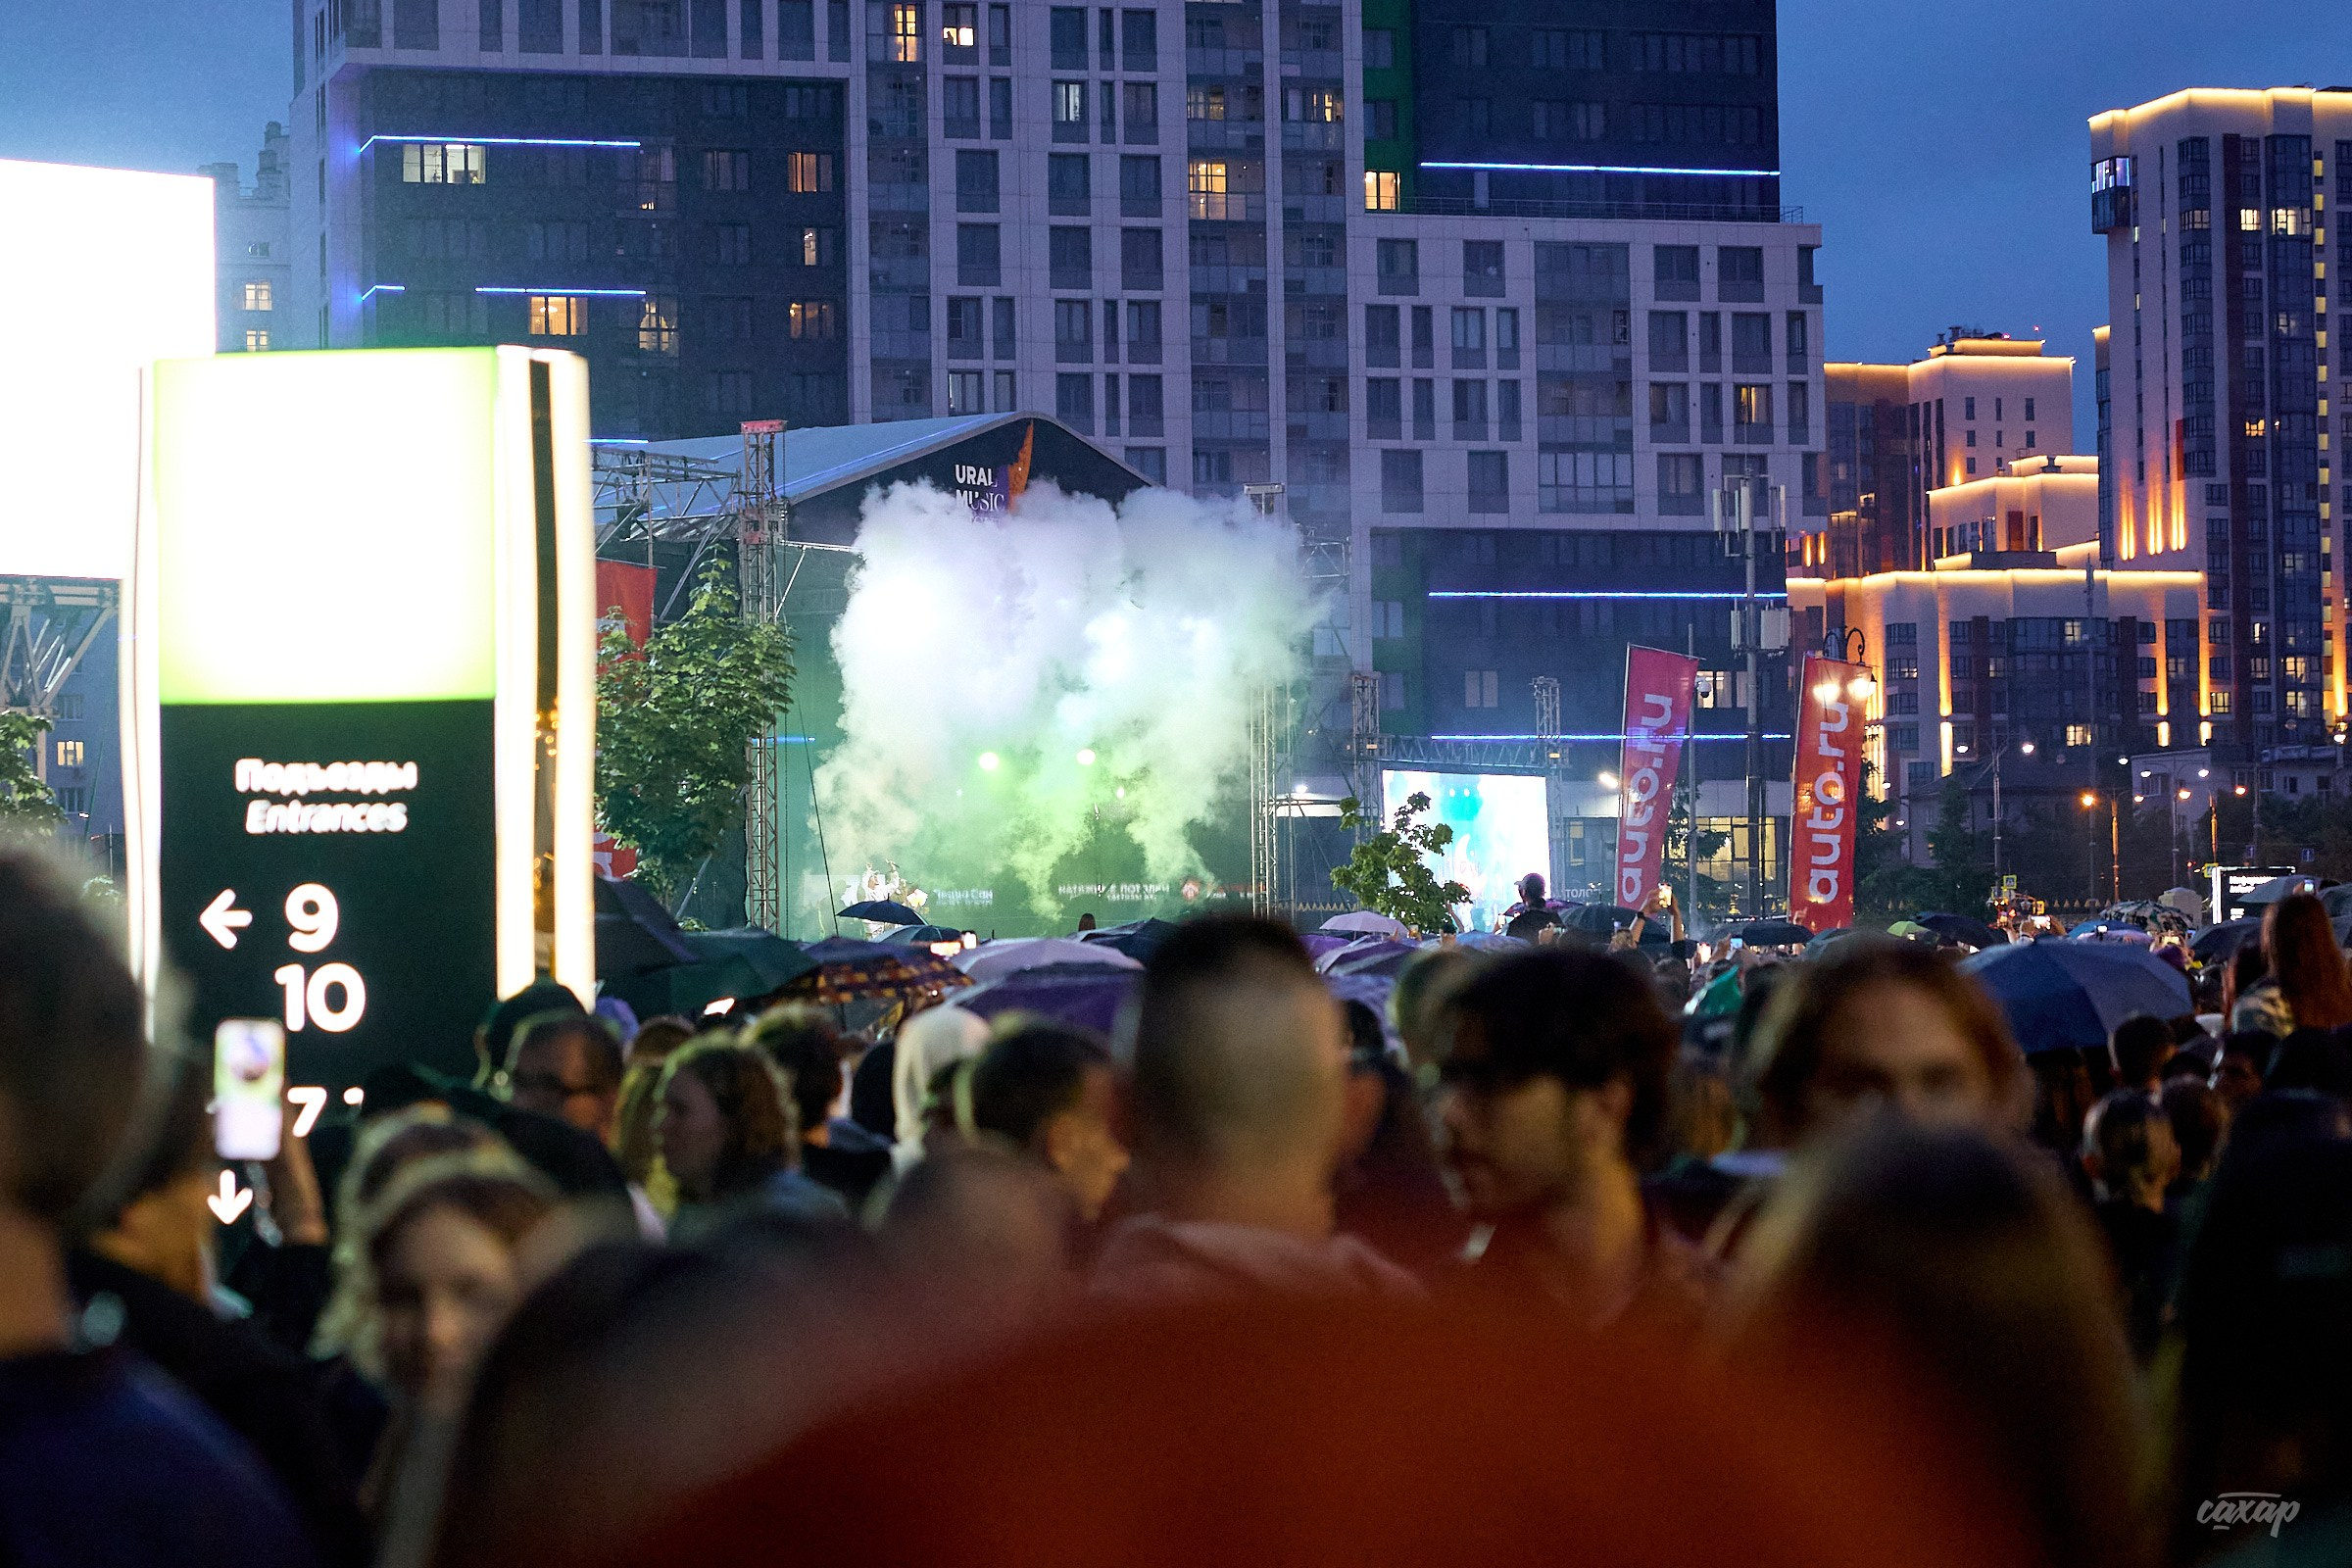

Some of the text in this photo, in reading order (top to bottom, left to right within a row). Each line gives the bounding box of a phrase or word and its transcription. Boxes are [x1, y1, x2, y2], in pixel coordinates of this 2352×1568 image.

[955, 464, 998, 488] URAL
[956, 489, 1005, 512] MUSIC
[245, 799, 408, 834] Entrances
[1621, 692, 1673, 904] auto.ru
[1806, 702, 1849, 904] auto.ru
[285, 883, 339, 953] 9
[274, 962, 367, 1032] 10
[287, 1087, 327, 1137] 7
